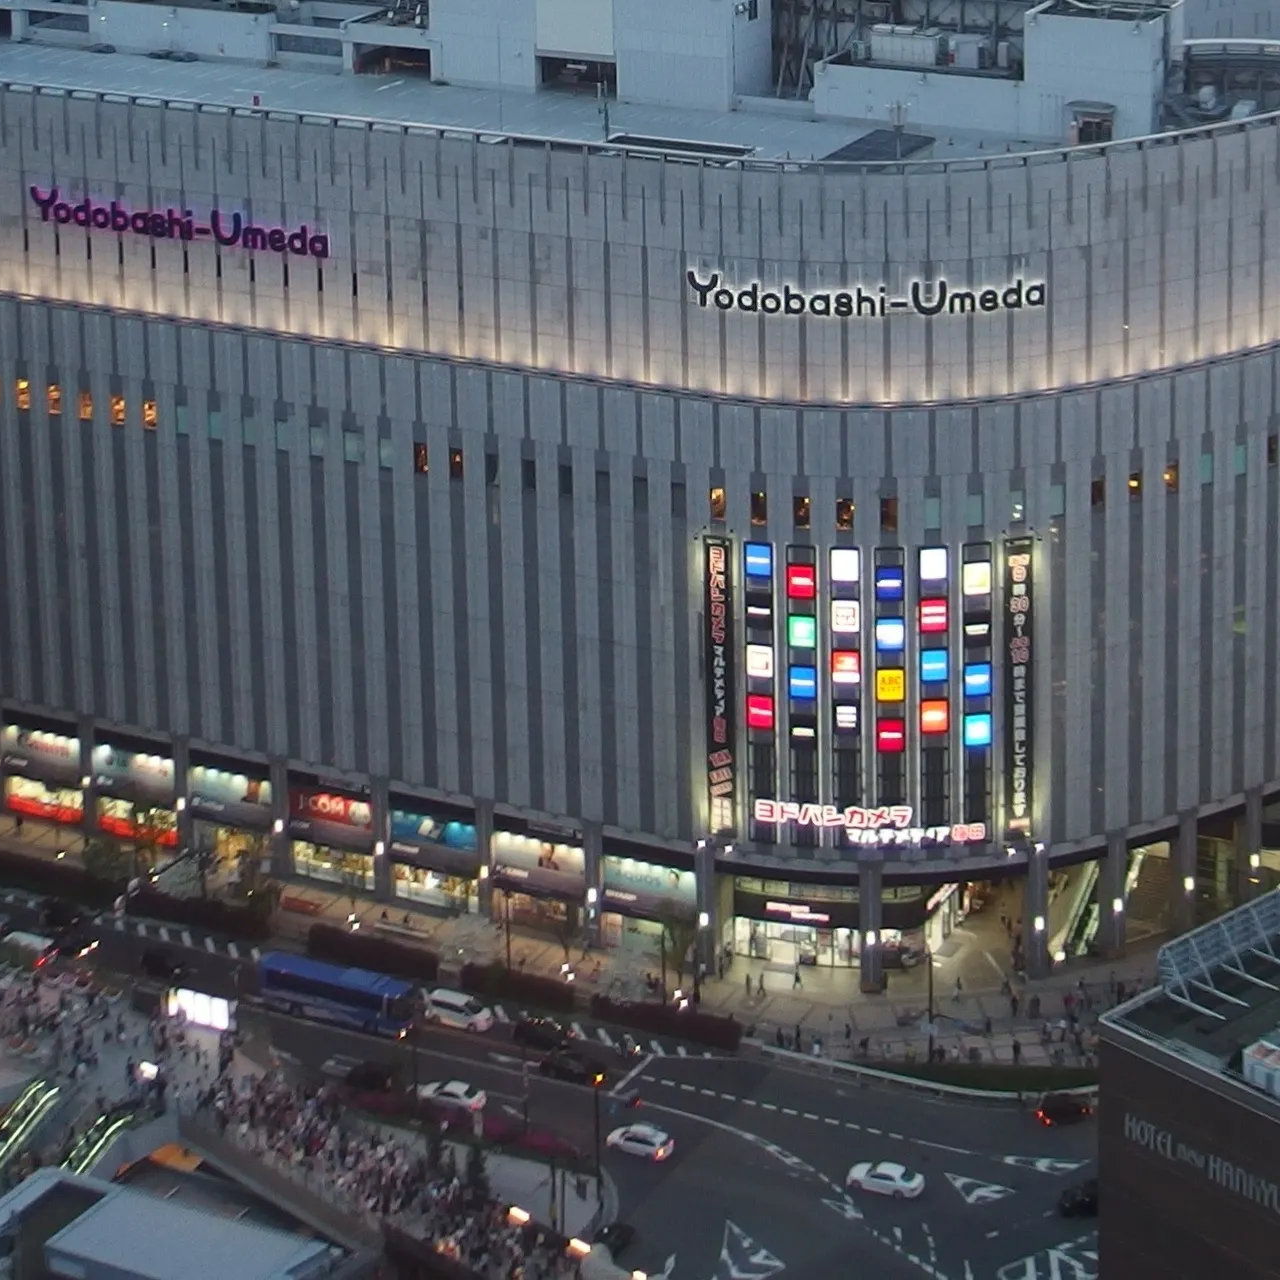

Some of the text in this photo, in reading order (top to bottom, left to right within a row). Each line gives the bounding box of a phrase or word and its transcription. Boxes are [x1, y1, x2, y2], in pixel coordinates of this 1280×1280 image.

[30, 184, 331, 259] Yodobashi-Umeda
[686, 269, 1046, 318] Yodobashi-Umeda
[754, 798, 913, 828] ヨドバシカメラ
[1124, 1112, 1177, 1161] HOTEL
